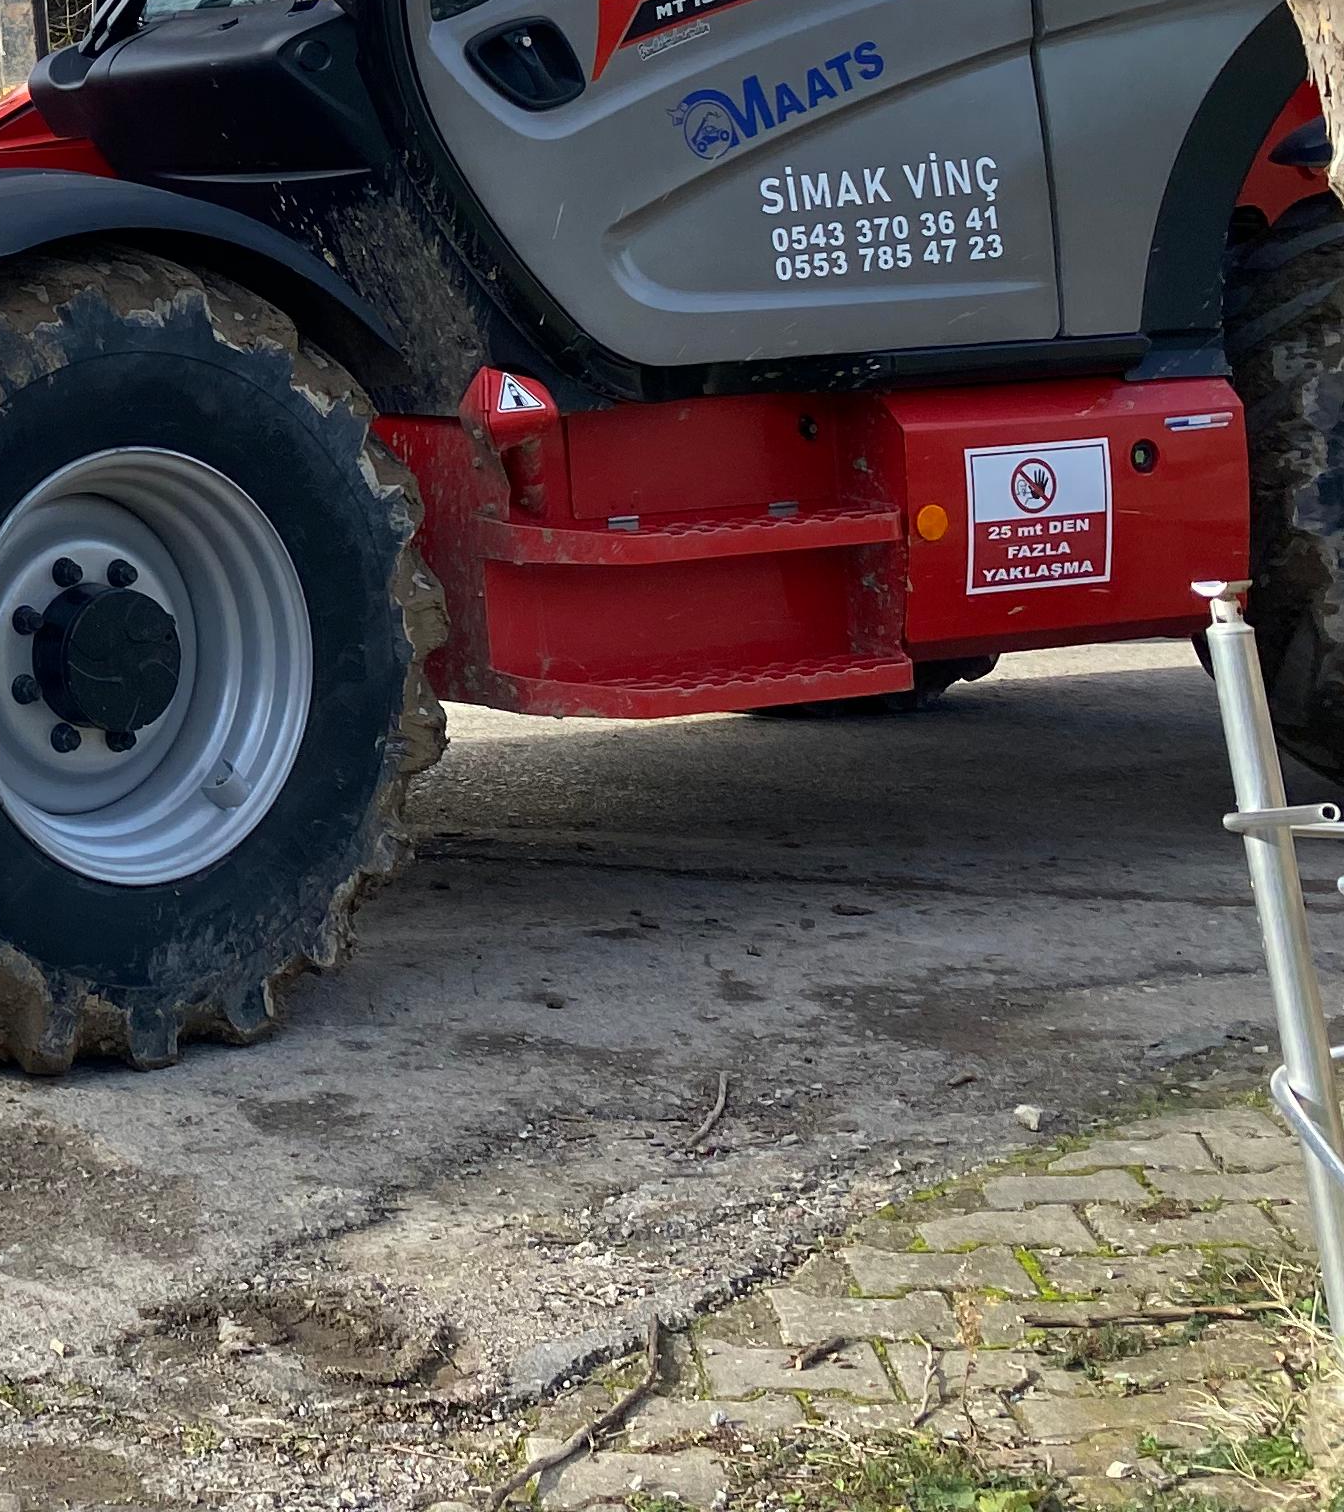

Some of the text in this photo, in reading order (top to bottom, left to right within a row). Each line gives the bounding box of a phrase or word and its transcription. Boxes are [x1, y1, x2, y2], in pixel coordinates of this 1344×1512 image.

[678, 41, 885, 152] MAATS
[760, 152, 1000, 215] SİMAK VİNÇ
[771, 205, 999, 253] 0543 370 36 41
[775, 234, 1004, 281] 0553 785 47 23
[987, 517, 1090, 540] 25 mt DEN
[1007, 541, 1071, 559] FAZLA
[982, 559, 1094, 583] YAKLAŞMA
